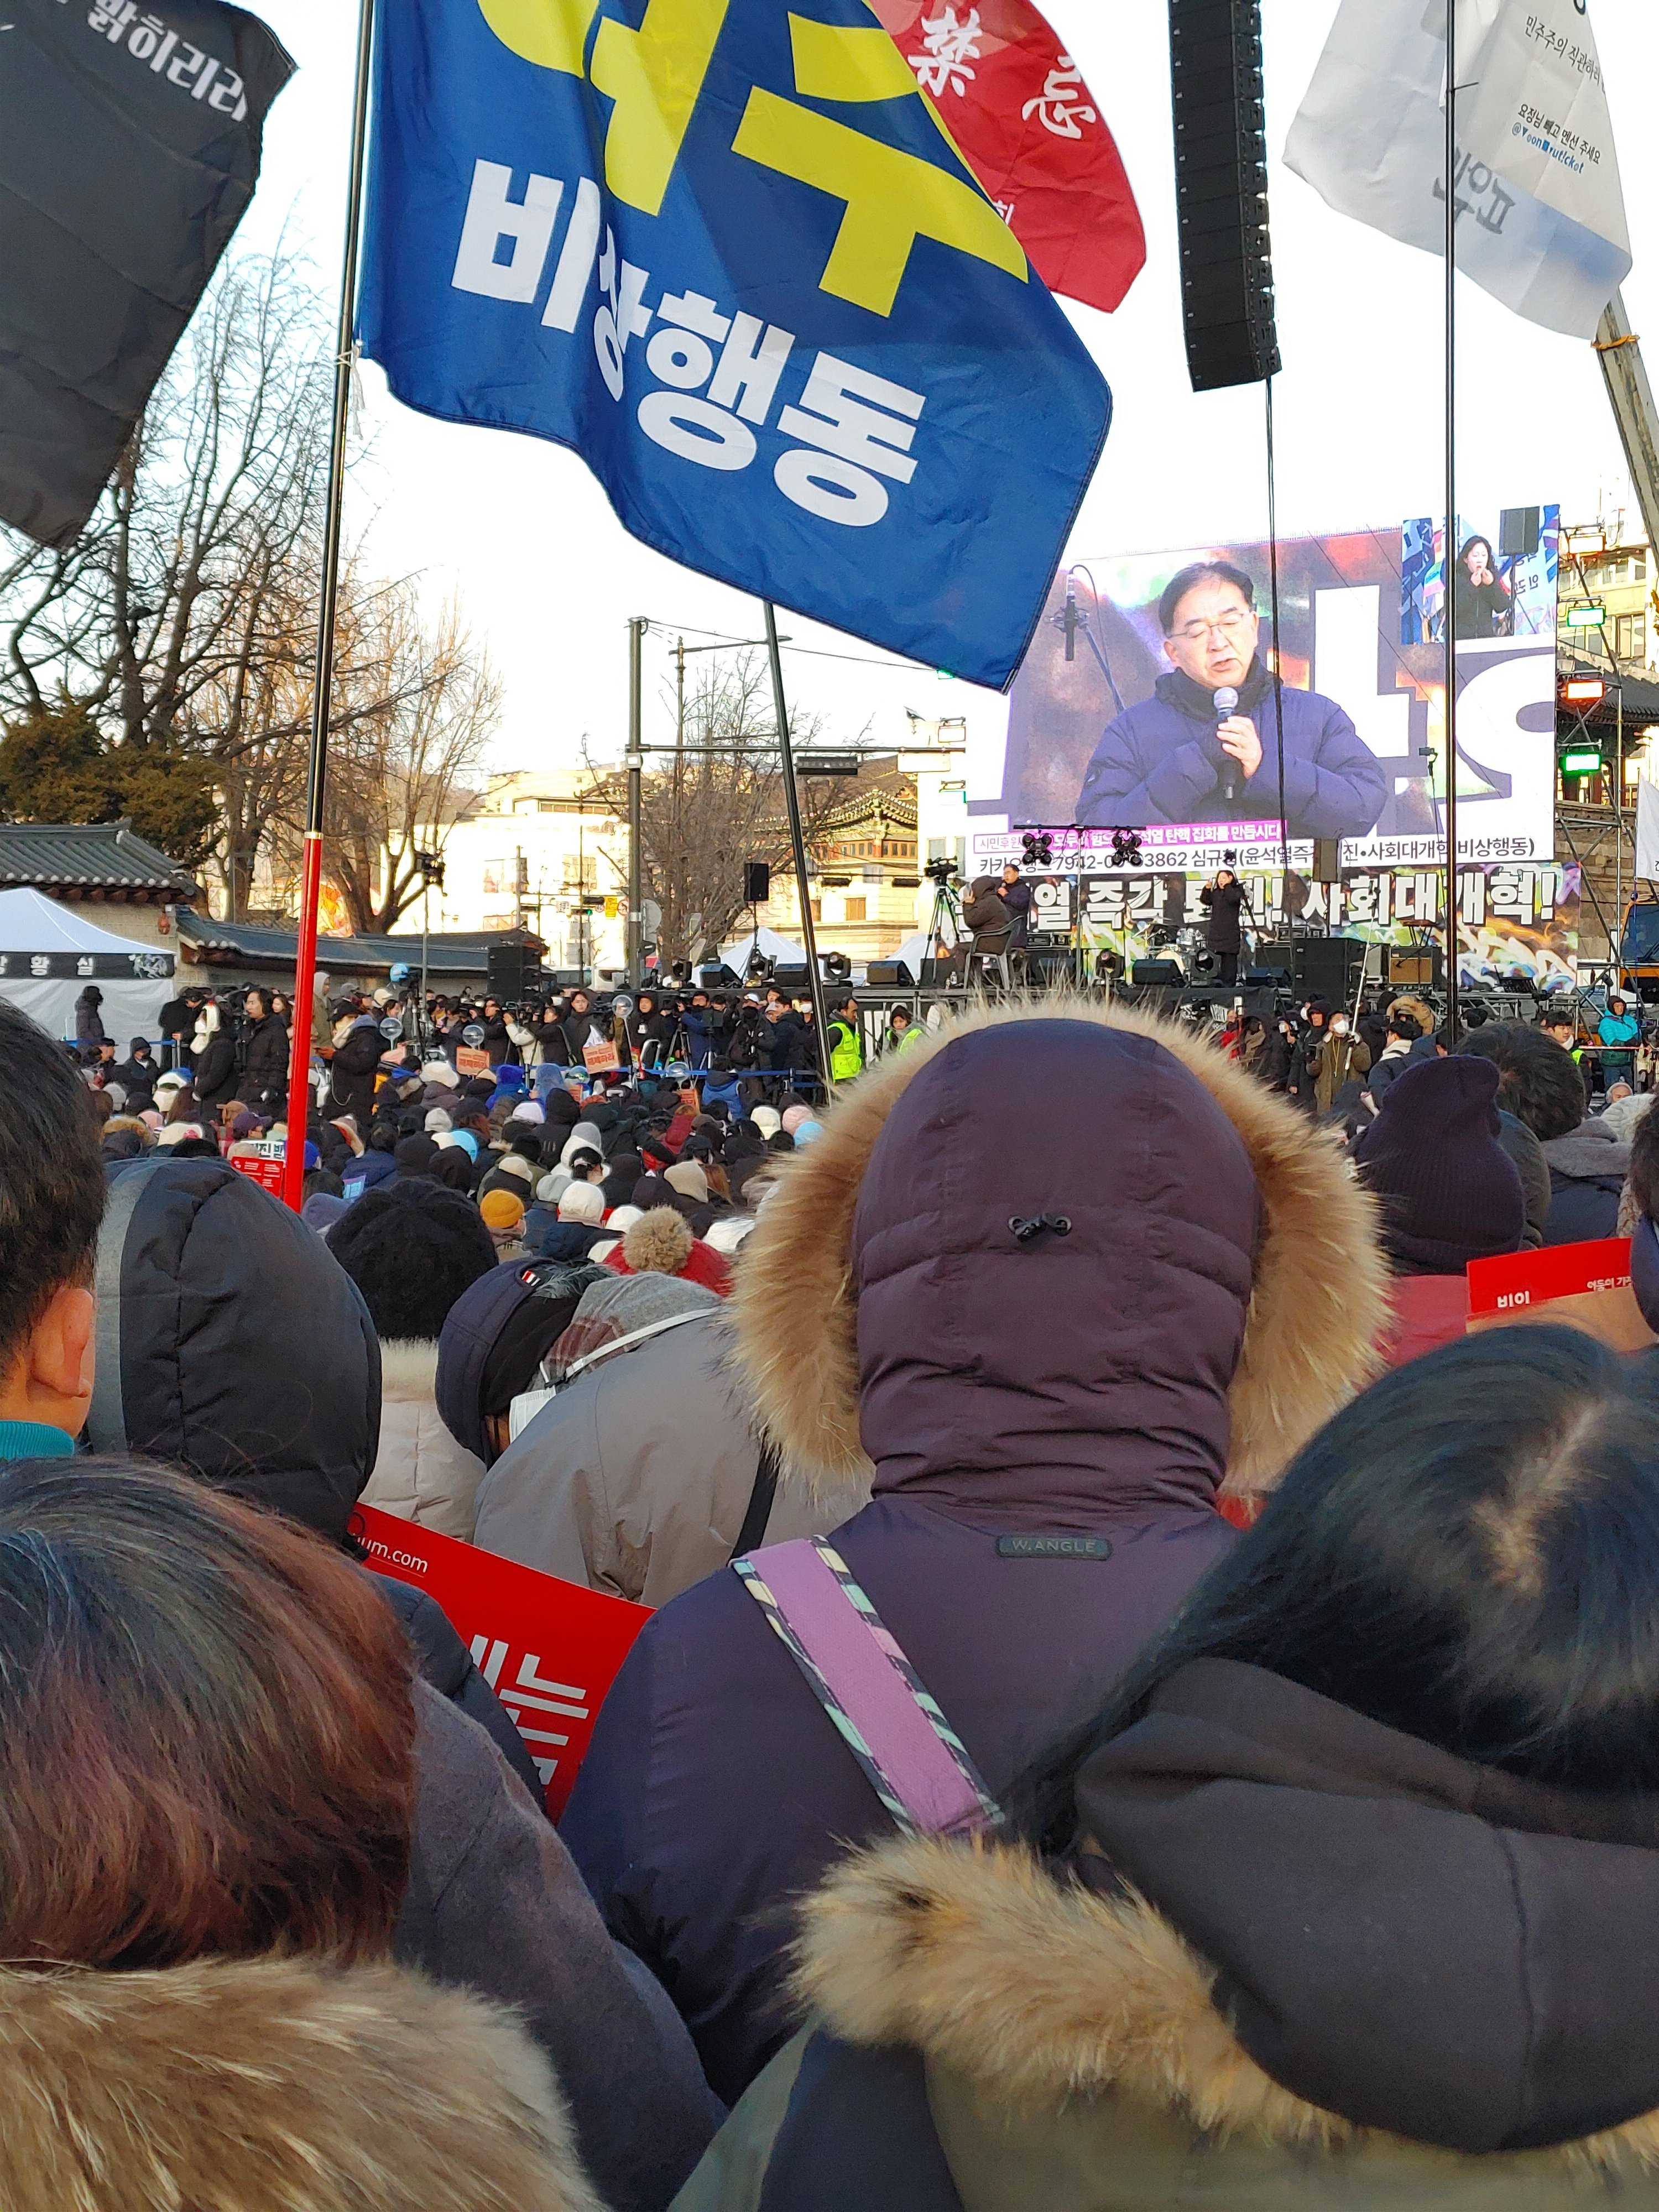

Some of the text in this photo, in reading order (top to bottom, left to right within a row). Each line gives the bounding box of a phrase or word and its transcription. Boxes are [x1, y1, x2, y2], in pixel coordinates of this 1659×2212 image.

[1525, 15, 1568, 58] 민주주의
[1518, 104, 1545, 129] 요정님
[1561, 129, 1580, 151] 멘션
[1579, 140, 1601, 164] 주세요
[451, 158, 926, 527] 비상행동
[1165, 827, 1191, 843] 탄핵
[1192, 825, 1228, 842] 집회를
[1087, 879, 1168, 930] 즉각
[1012, 1540, 1096, 1553] W.ANGLE
